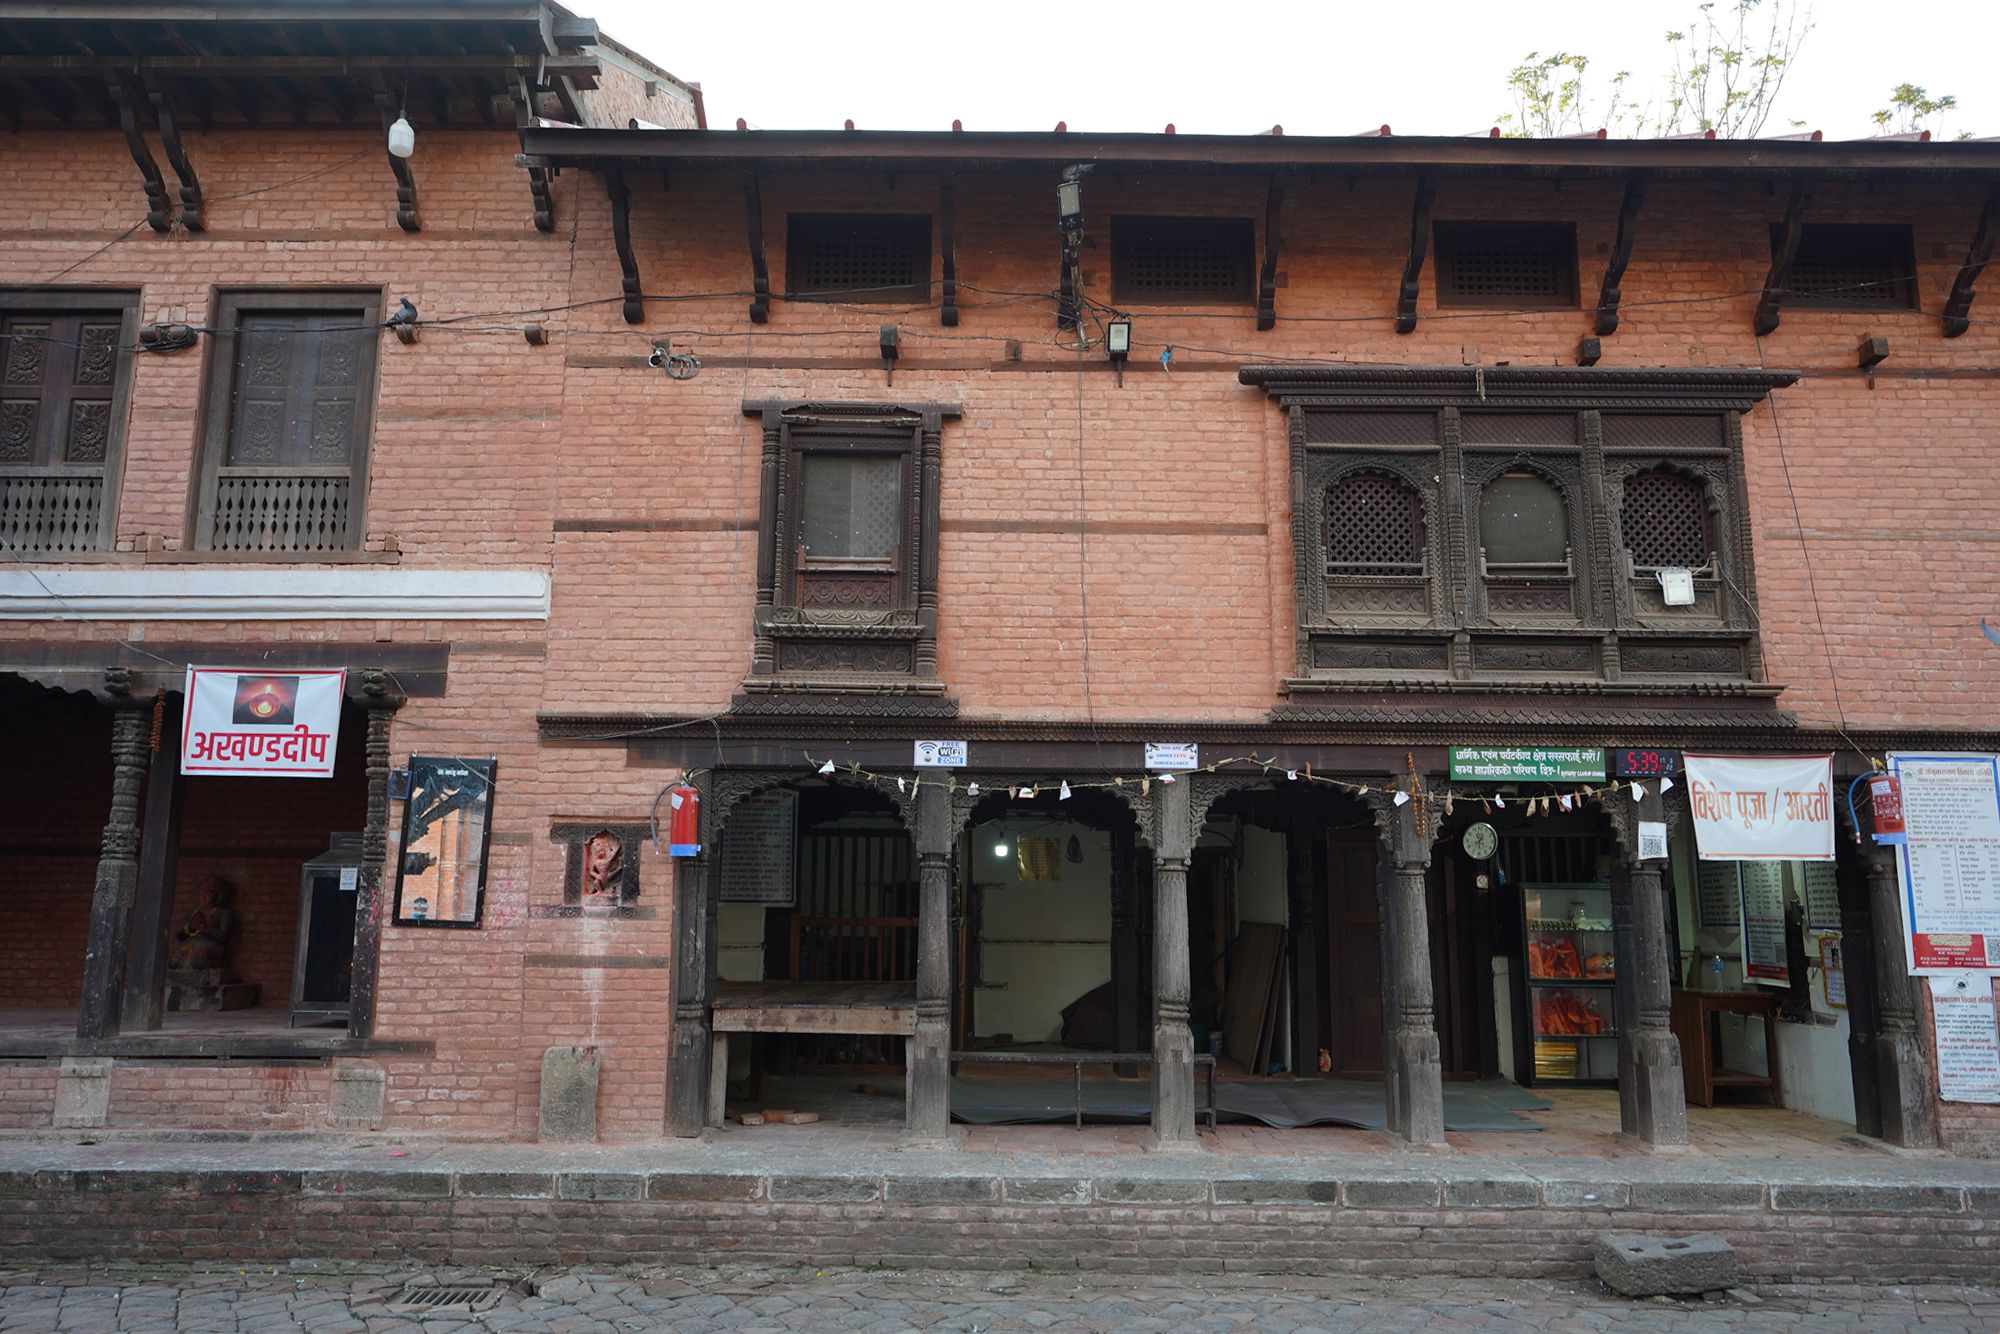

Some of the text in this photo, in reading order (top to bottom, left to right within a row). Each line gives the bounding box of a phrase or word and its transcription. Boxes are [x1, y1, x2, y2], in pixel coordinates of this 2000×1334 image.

[191, 724, 330, 762] अखण्डदीप
[1455, 748, 1479, 760] धार्मिक
[1533, 749, 1546, 763] क्षेत्र
[1627, 751, 1659, 771] 5:39
[1455, 764, 1473, 776] सभ्य
[1474, 763, 1511, 777] नागरिकको
[1512, 763, 1537, 777] परिचय
[1691, 780, 1732, 822] विशेष
[1736, 791, 1767, 830] पूजा
[1772, 787, 1779, 824] /
[1784, 782, 1829, 822] आरती
